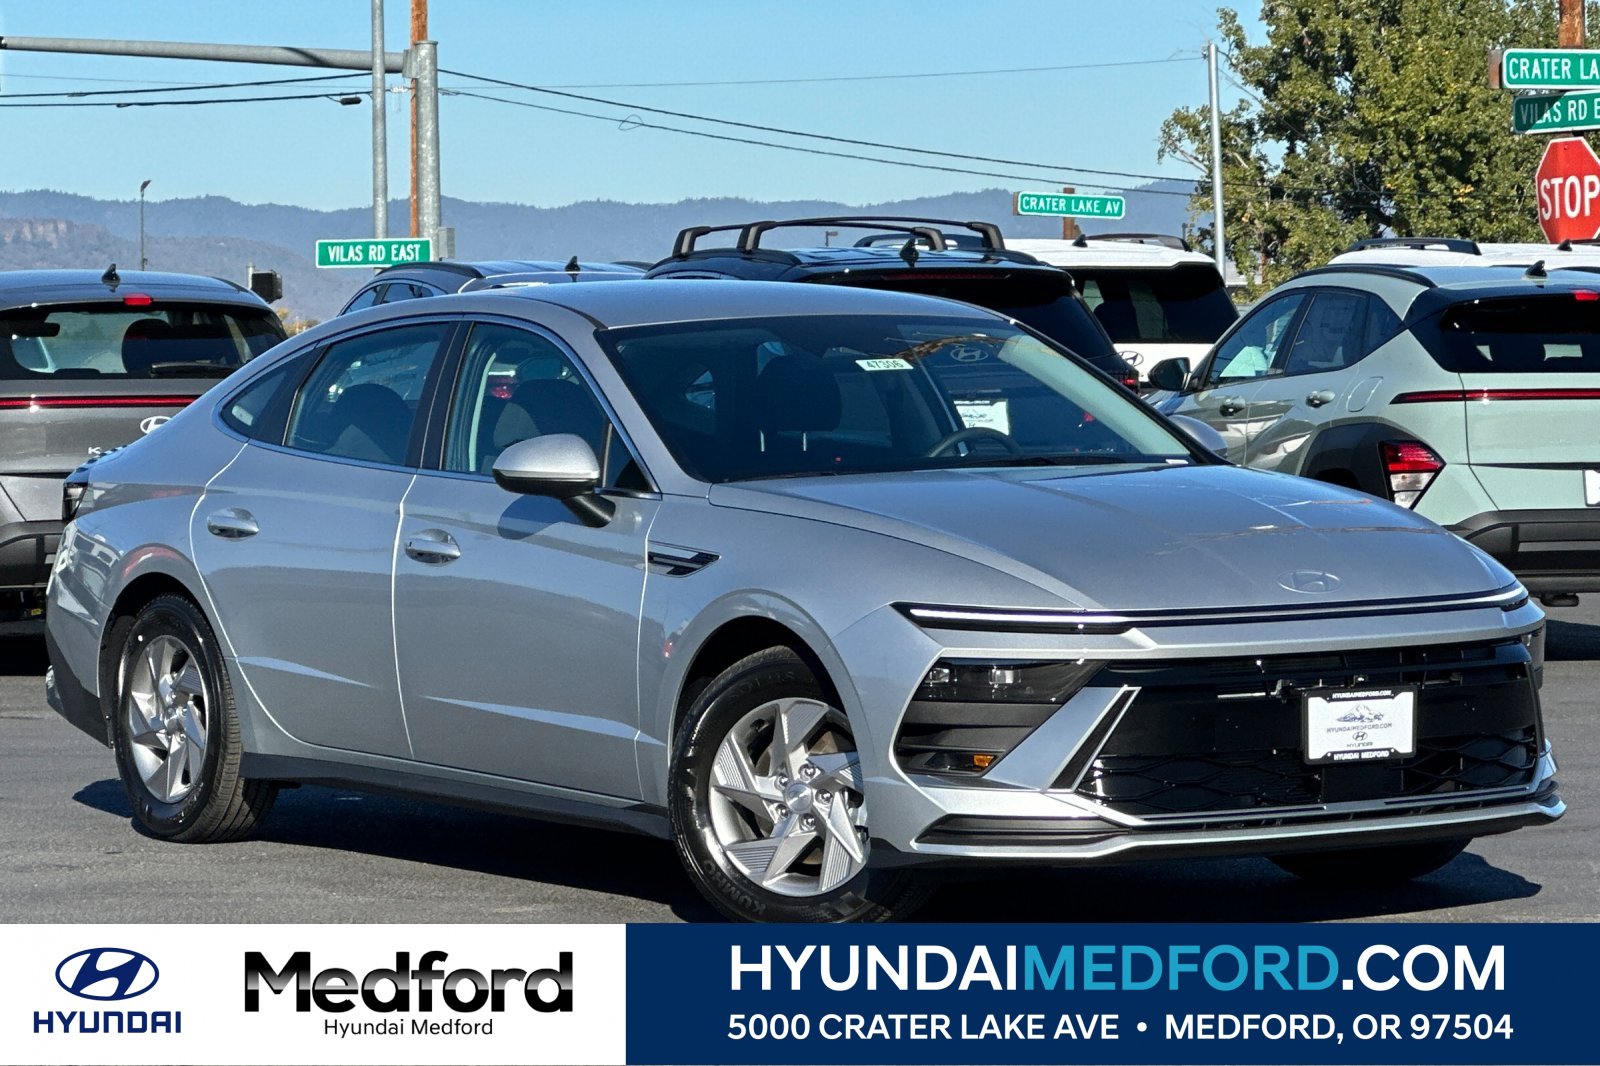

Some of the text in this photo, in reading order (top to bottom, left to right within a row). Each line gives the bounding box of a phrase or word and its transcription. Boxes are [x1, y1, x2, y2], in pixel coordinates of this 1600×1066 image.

[1508, 58, 1571, 80] CRATER
[1520, 101, 1562, 125] VILAS
[1567, 99, 1587, 121] RD
[1022, 196, 1120, 214] CRATER LAKE AV
[1540, 174, 1600, 221] STOP
[328, 243, 421, 262] VILAS RD EAST
[1326, 722, 1393, 734] HYUNDAIMEDFORD.COM
[1333, 750, 1390, 761] HYUNDAI MEDFORD
[703, 860, 767, 914] KUMHO
